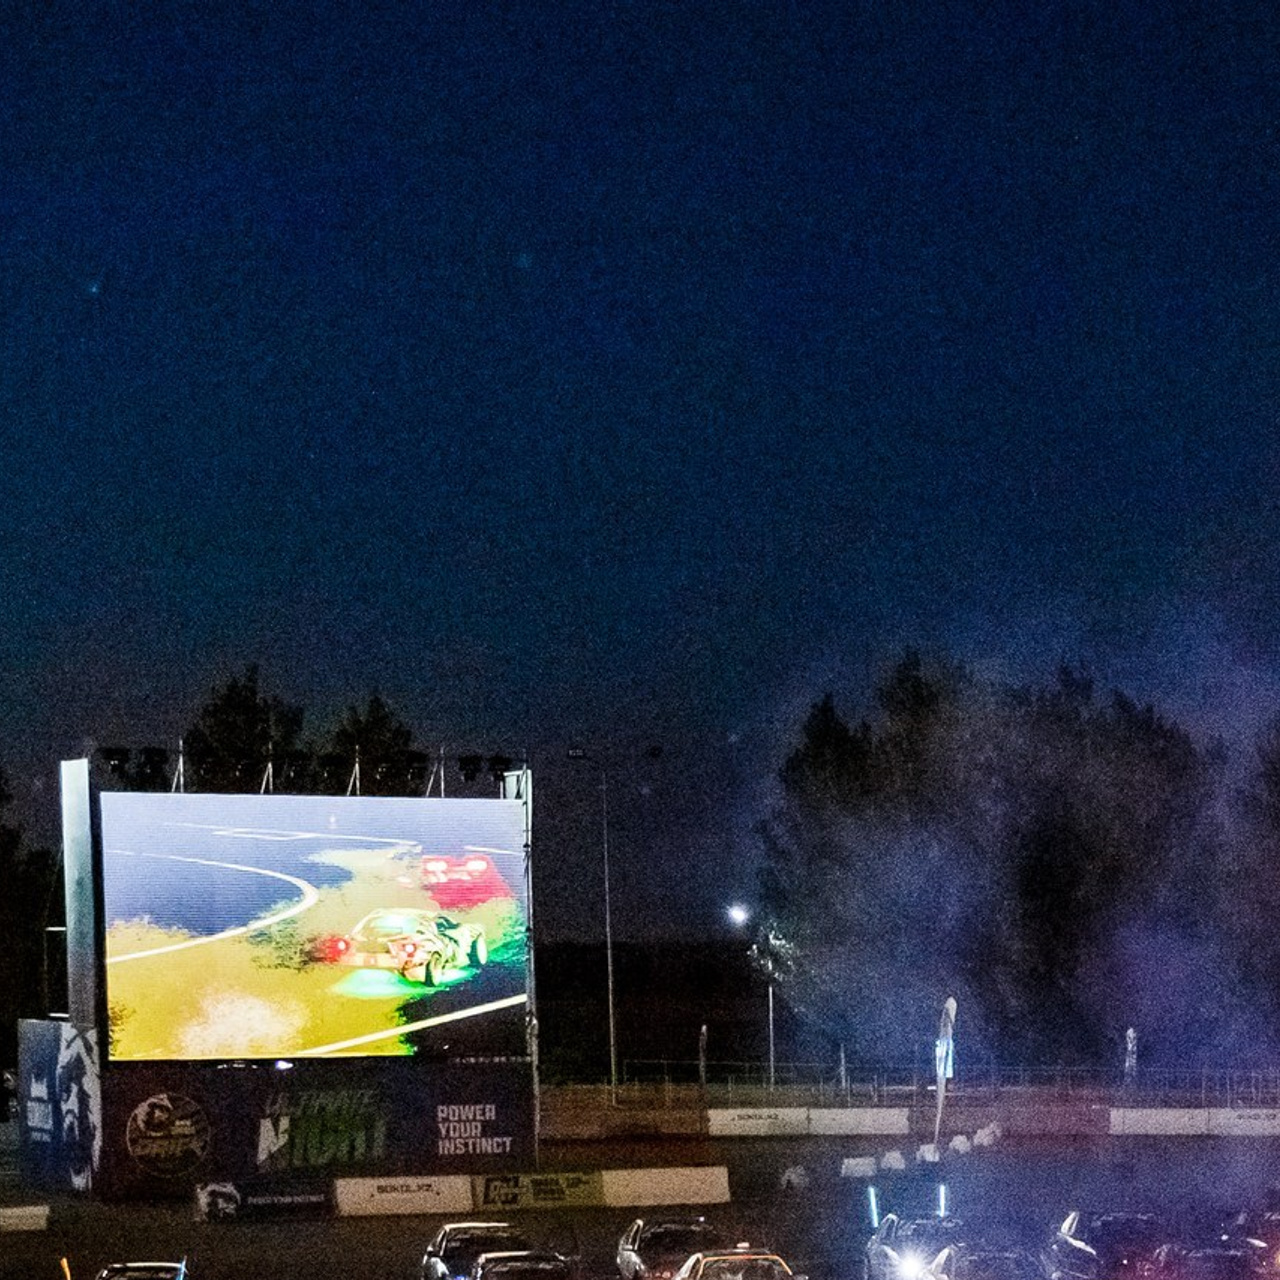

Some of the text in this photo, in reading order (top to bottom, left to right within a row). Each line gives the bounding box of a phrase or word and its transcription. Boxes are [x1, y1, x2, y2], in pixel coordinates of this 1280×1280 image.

[437, 1104, 496, 1122] POWER
[438, 1122, 482, 1138] YOUR
[438, 1137, 512, 1155] INSTINCT
